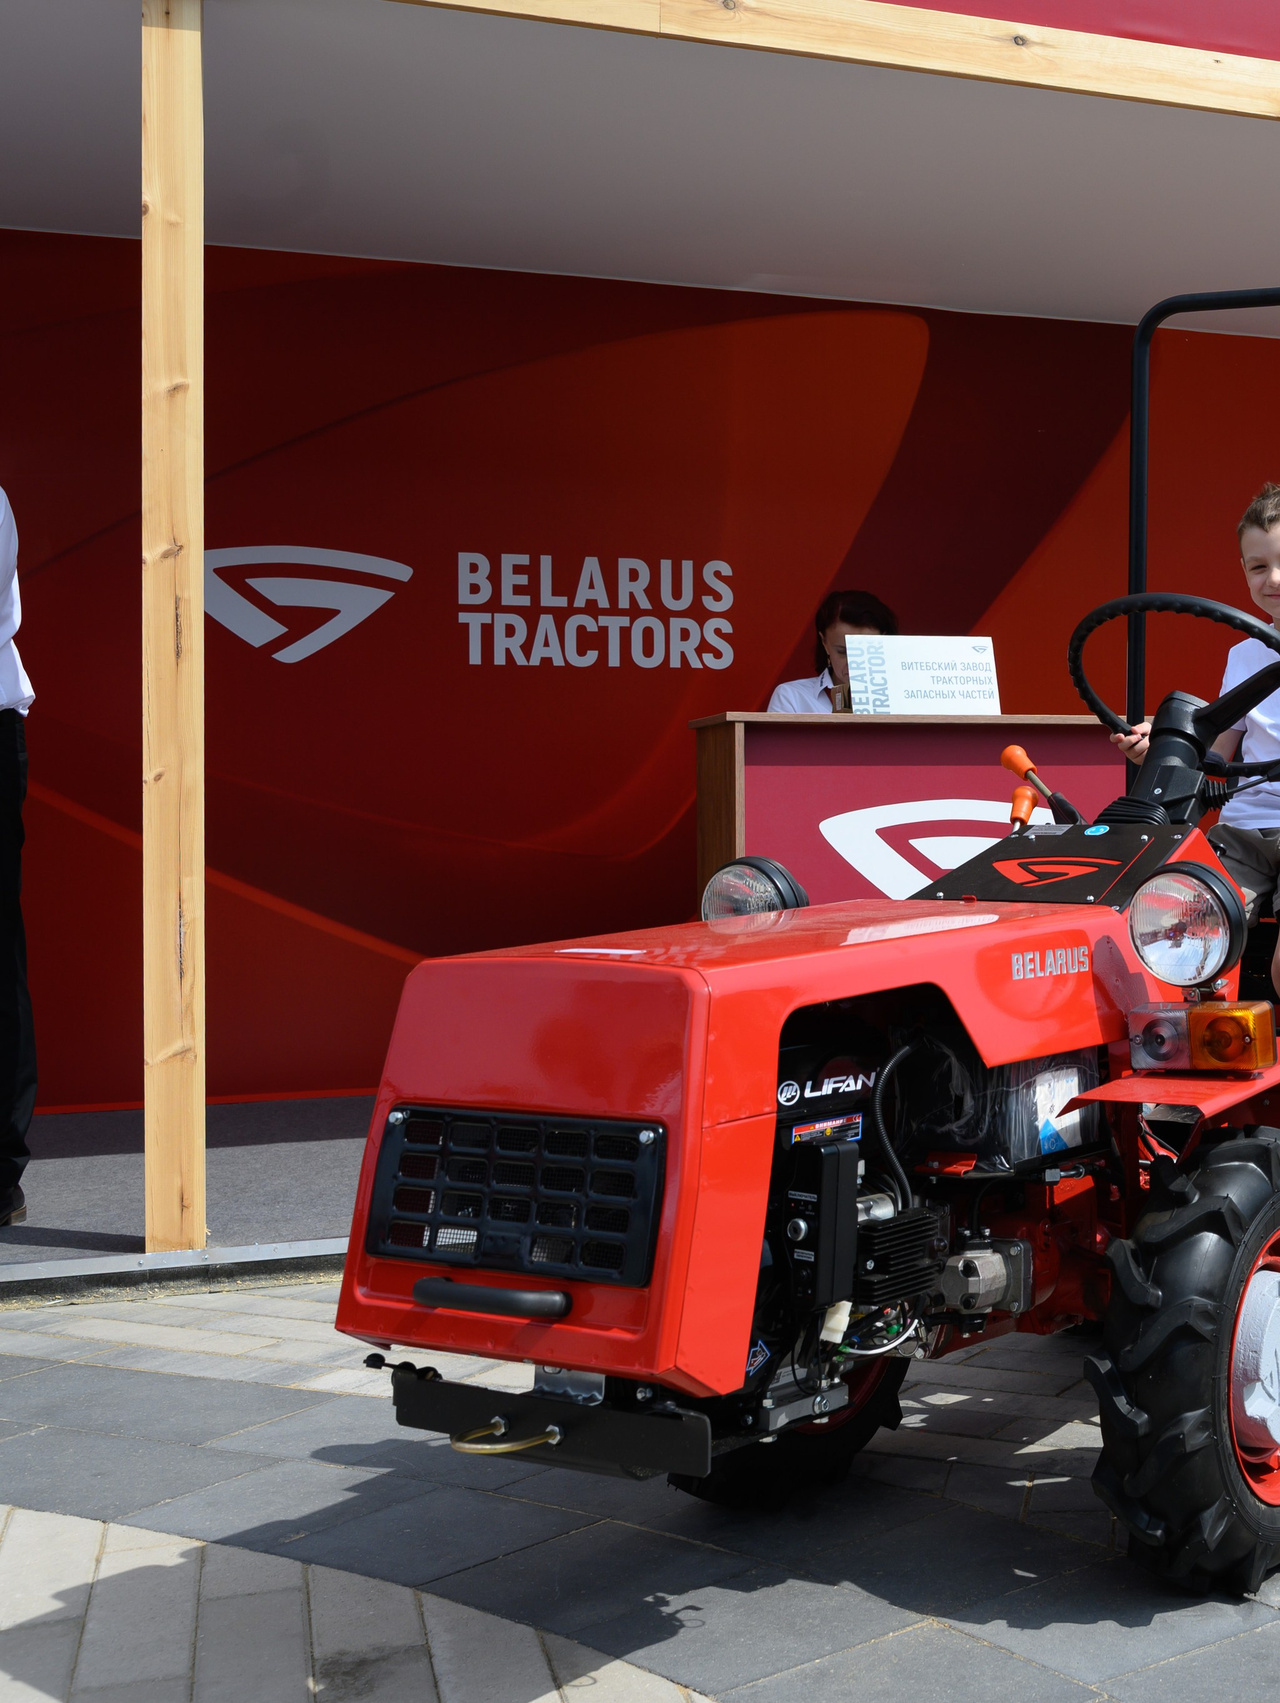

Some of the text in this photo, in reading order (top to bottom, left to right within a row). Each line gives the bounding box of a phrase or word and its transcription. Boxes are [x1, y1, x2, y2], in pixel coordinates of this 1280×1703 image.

[458, 552, 734, 612] BELARUS
[458, 612, 734, 670] TRACTORS
[850, 637, 870, 714] BELARU
[900, 660, 992, 672] ВИТЕБСКИЙ ЗАВОД
[930, 675, 993, 685] ТРАКТОРНЫХ
[903, 688, 995, 700] ЗАПАСНЫХ ЧАСТЕЙ
[1011, 946, 1089, 980] BELARUS
[804, 1072, 876, 1098] LIFAN
